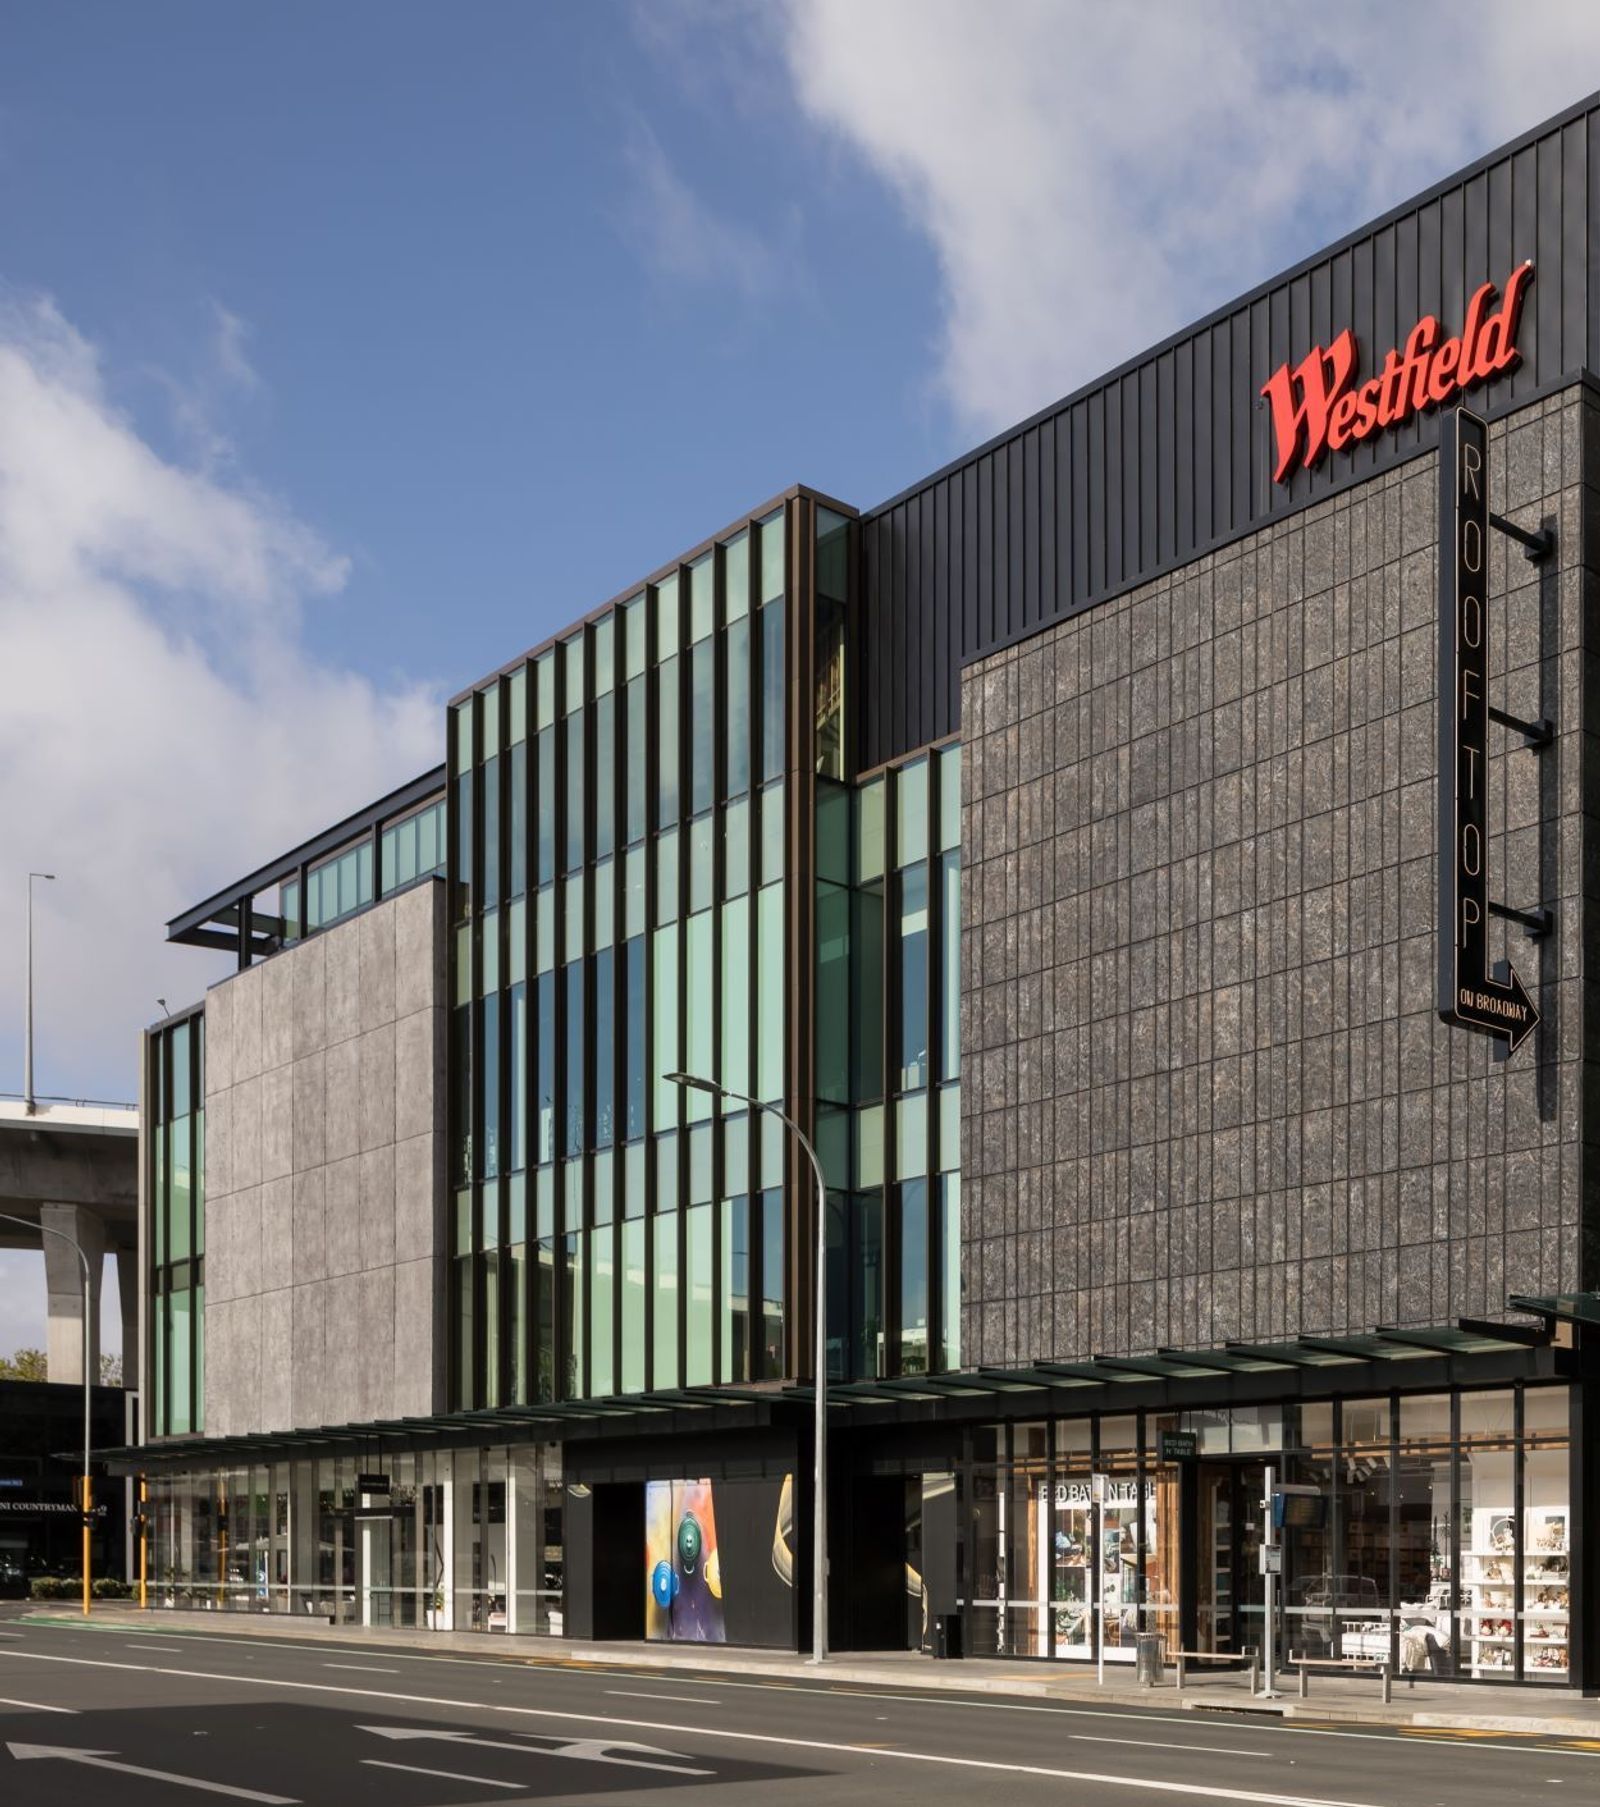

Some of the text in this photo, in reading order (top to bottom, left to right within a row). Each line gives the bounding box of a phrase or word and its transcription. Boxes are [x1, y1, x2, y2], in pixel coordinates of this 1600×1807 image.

[1260, 259, 1535, 484] Westfield
[1463, 442, 1482, 950] ROOFTOP
[1460, 988, 1528, 1021] ON BROADWAY
